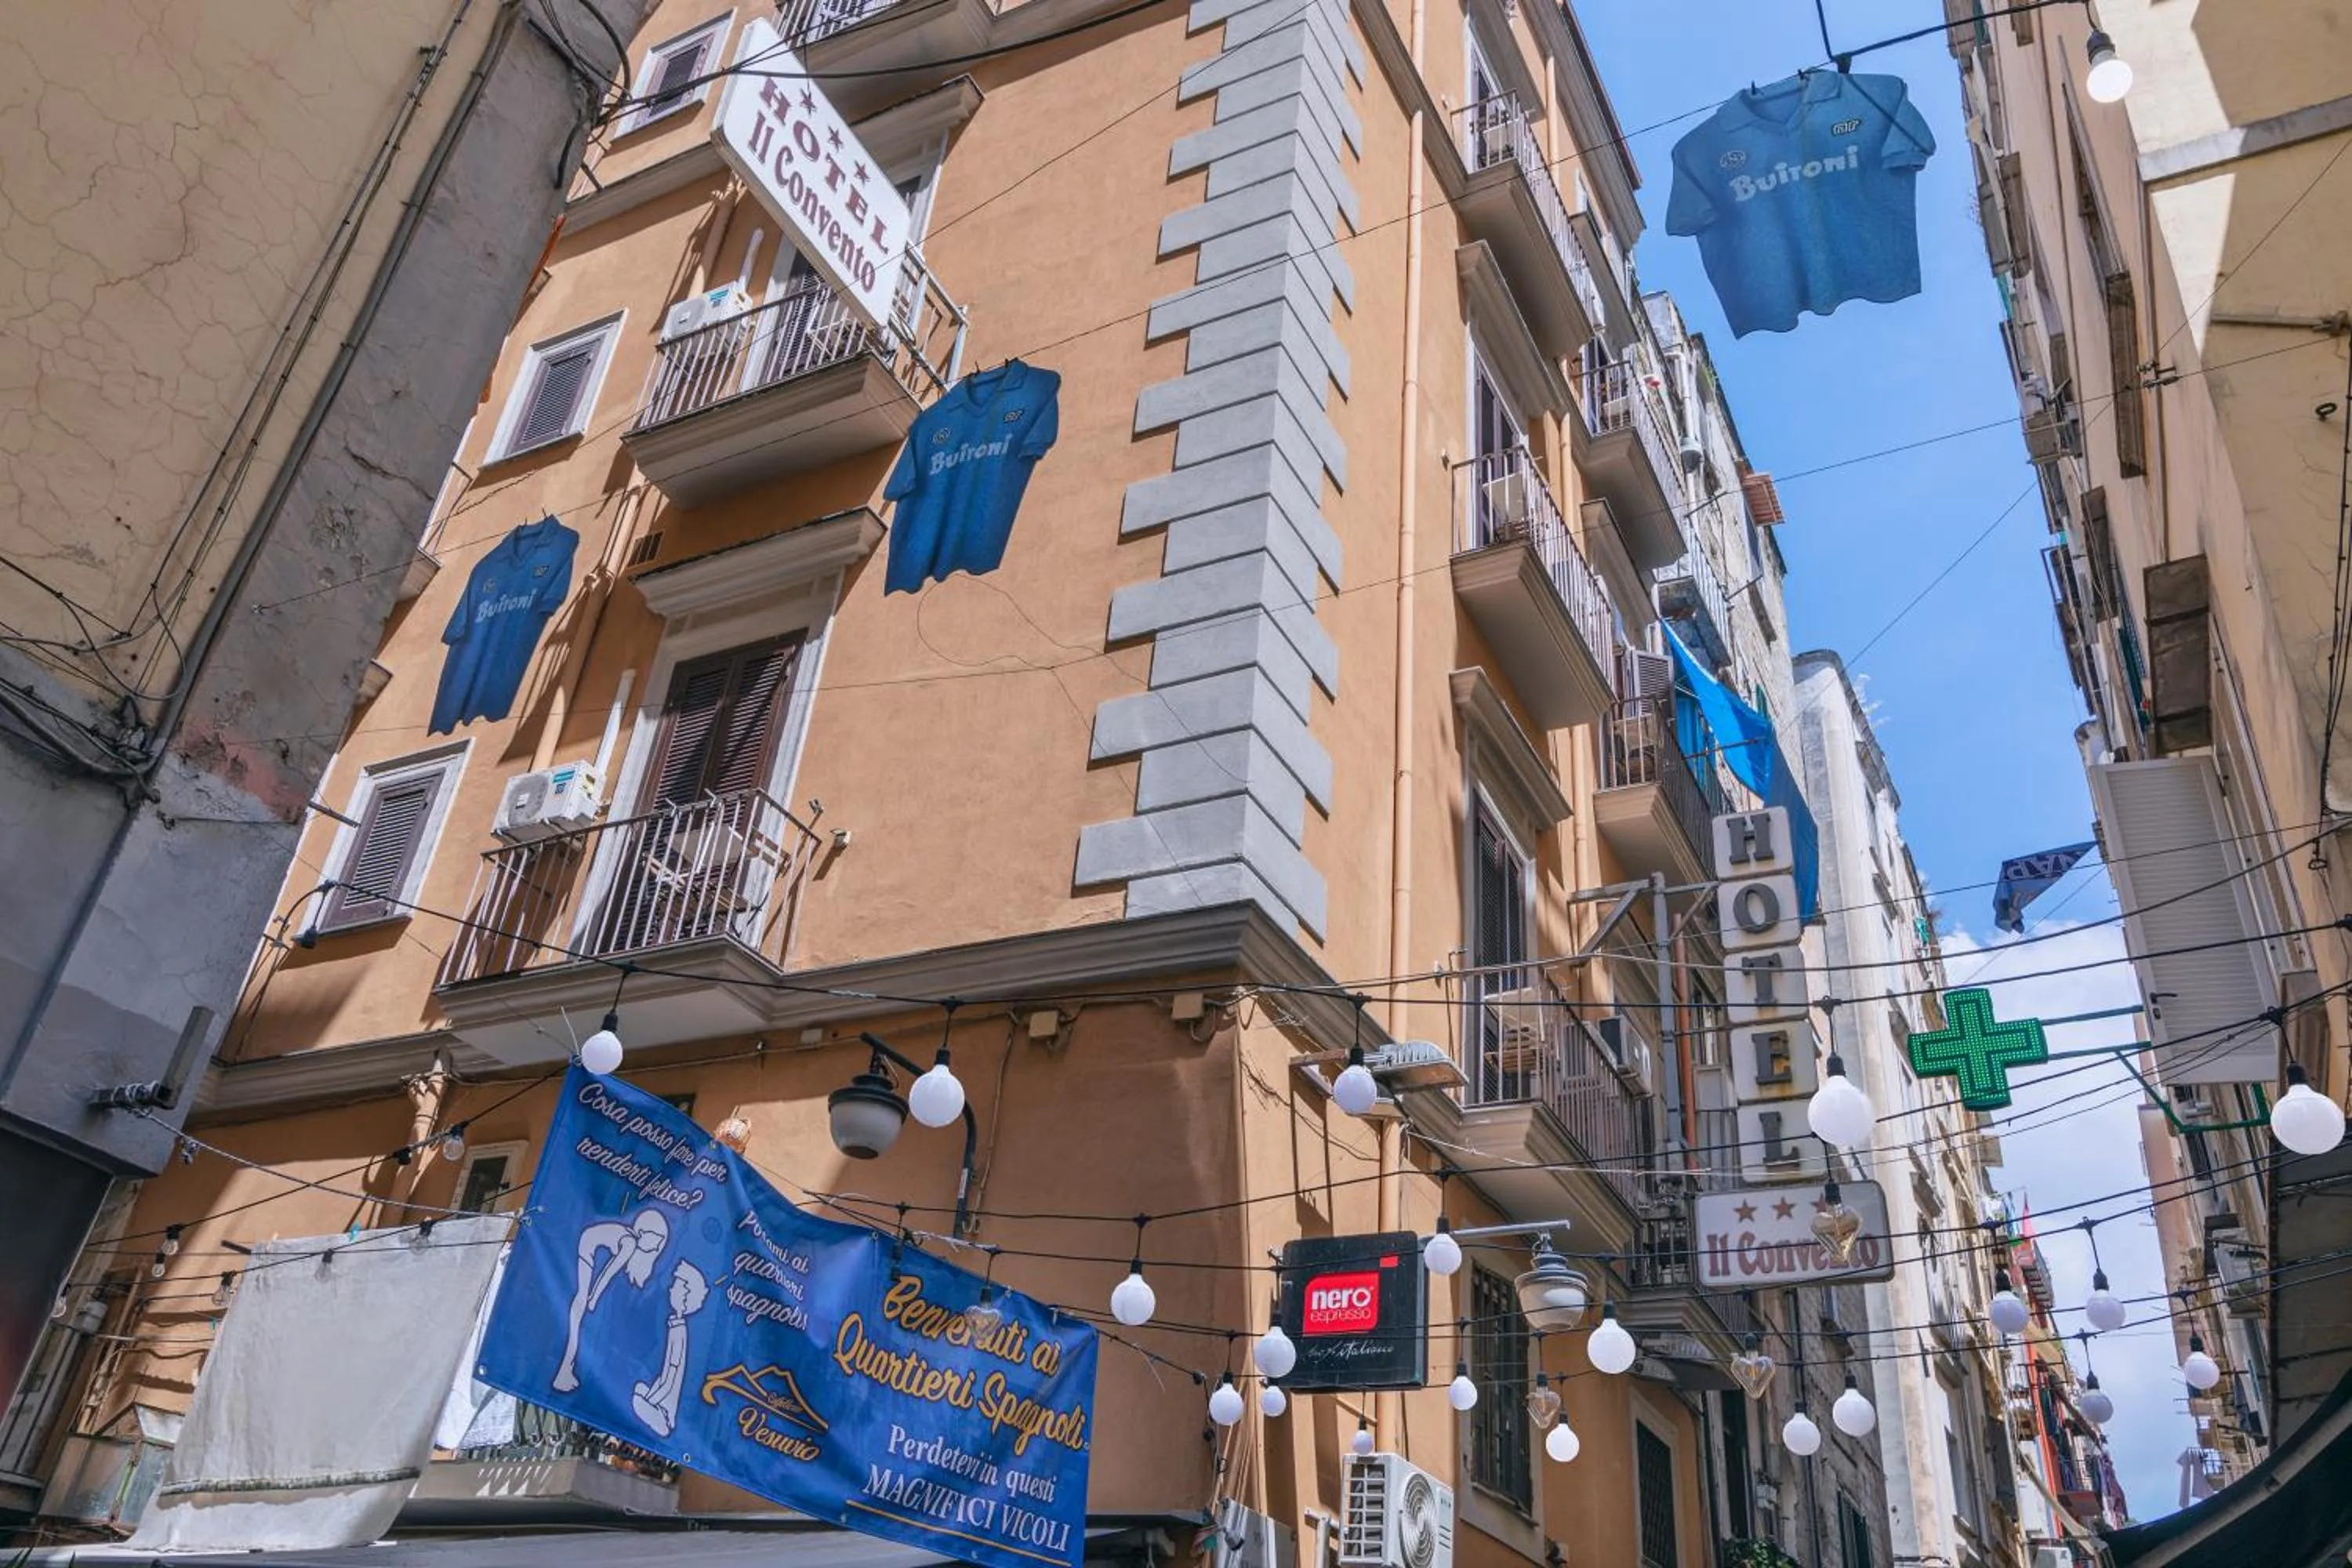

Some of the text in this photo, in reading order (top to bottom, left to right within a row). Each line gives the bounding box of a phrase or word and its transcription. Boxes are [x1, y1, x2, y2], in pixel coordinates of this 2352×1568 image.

[758, 78, 889, 256] HOTEL
[748, 111, 877, 294] Il Convento
[1726, 812, 1800, 1167] HOTEL
[577, 1136, 652, 1187] renderti
[579, 1083, 728, 1182] Cosa posso fare per
[791, 1256, 808, 1274] ai
[1707, 1232, 1730, 1277] Il
[1310, 1307, 1371, 1324] espresso
[1312, 1286, 1371, 1311] nero
[833, 1313, 1086, 1456] Quartieri Spagnoli
[1032, 1340, 1061, 1377] ai
[739, 1407, 819, 1461] Vesuvio
[888, 1424, 1058, 1503] Perdetevi in questi
[863, 1464, 1071, 1552] MAGNIFICI VICOLI
